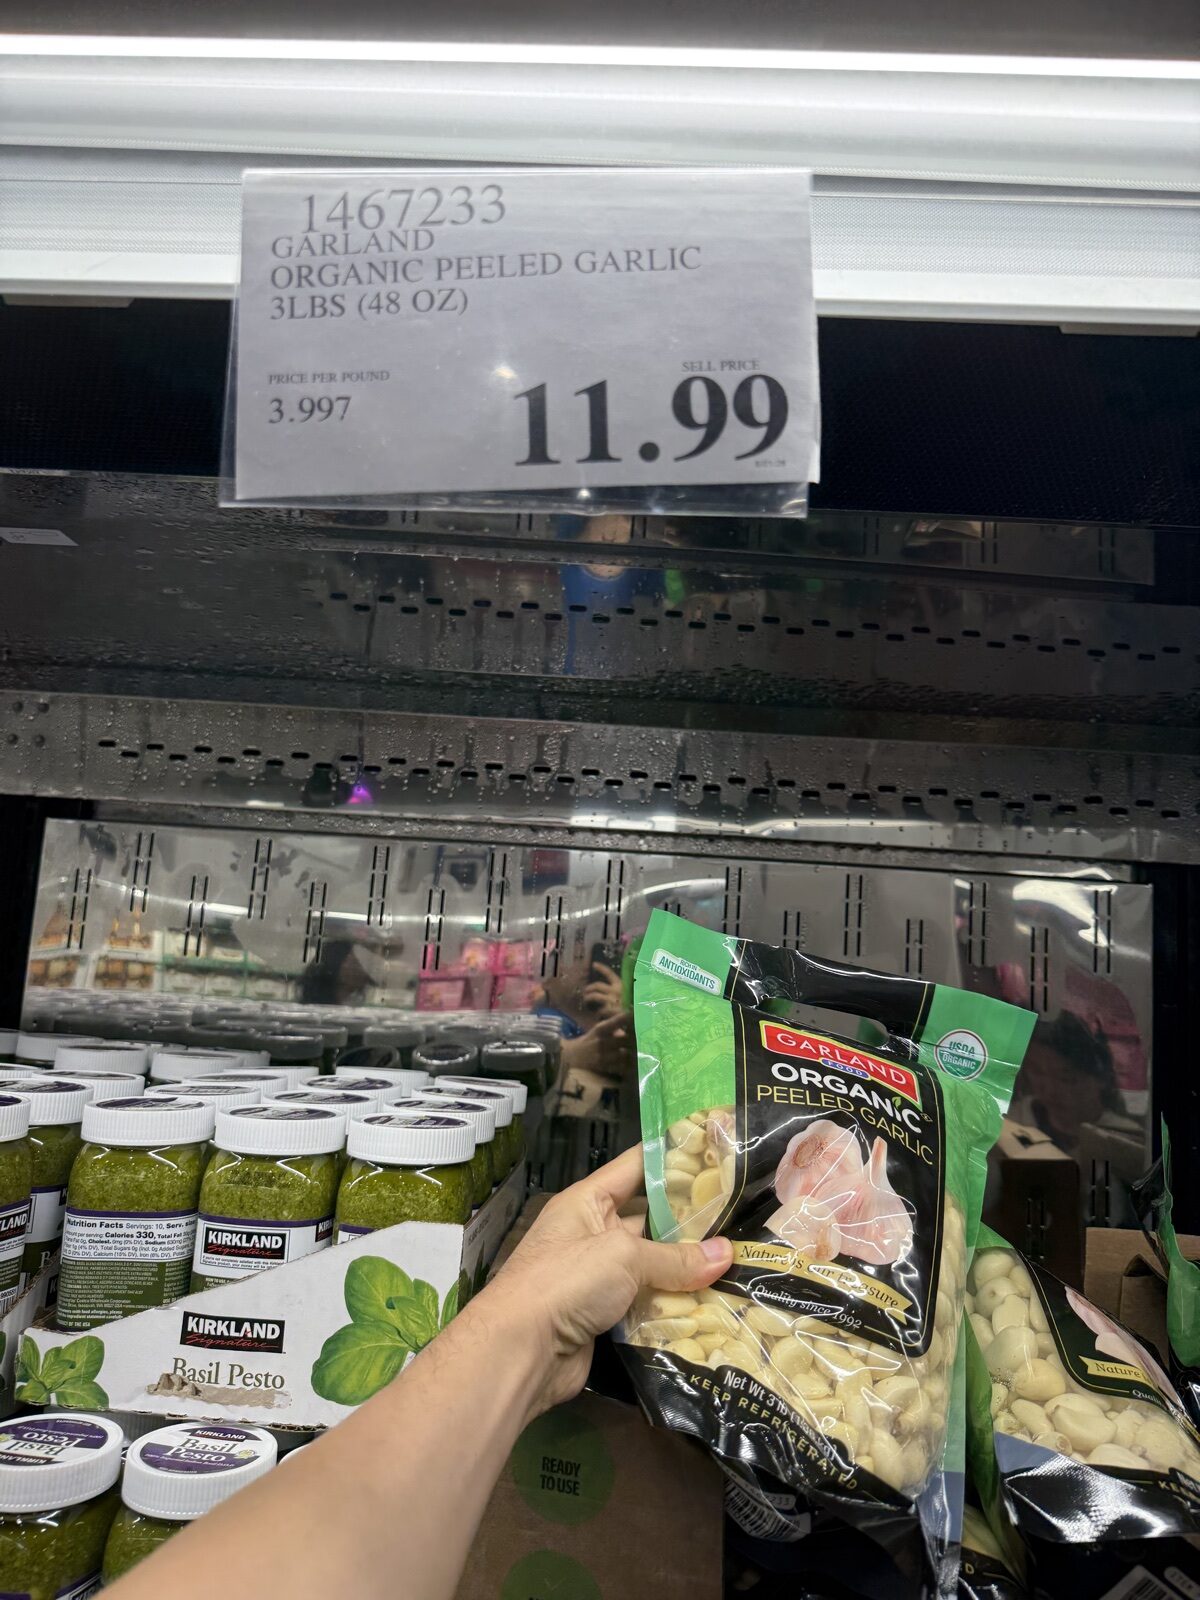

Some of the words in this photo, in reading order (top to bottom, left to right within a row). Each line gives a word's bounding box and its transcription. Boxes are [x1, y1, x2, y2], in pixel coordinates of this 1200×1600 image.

[302, 184, 506, 234] 1467233
[271, 229, 435, 259] GARLAND
[270, 258, 424, 290] ORGANIC
[436, 253, 563, 281] PEELED
[574, 246, 701, 274] GARLIC
[270, 294, 347, 320] 3LBS
[357, 291, 401, 321] (48
[411, 288, 469, 317] OZ)
[268, 372, 309, 385] PRICE
[312, 372, 338, 384] PER
[342, 370, 391, 383] POUND
[681, 361, 716, 373] SELL
[720, 359, 761, 372] PRICE
[268, 395, 352, 424] 3.997
[512, 373, 790, 467] 11.99
[658, 955, 716, 990] ANTIOXIDANTS
[776, 1032, 907, 1086] GARLAND
[949, 1041, 976, 1055] USDA
[826, 1060, 864, 1077] FOOD
[942, 1052, 976, 1070] ORGANIC
[771, 1062, 923, 1134] ORGANIC
[756, 1084, 855, 1113] PEELED
[859, 1105, 934, 1166] GARLIC
[67, 1218, 97, 1228] Nutrition
[99, 1221, 124, 1229] Facts
[125, 1223, 154, 1231] Servings:
[105, 1231, 135, 1239] Calories
[136, 1231, 157, 1240] 330,
[207, 1230, 283, 1249] KIRKLAND
[207, 1243, 282, 1256] Signature
[754, 1284, 799, 1309] Quality
[799, 1297, 832, 1316] since
[833, 1311, 863, 1331] 1992
[187, 1315, 281, 1340] KIRKLAND
[186, 1333, 279, 1350] Signature
[172, 1357, 221, 1386] Basil
[227, 1363, 286, 1389] Pesto
[1095, 1362, 1141, 1379] Nature
[724, 1369, 746, 1391] Net
[749, 1380, 766, 1401] Wt
[766, 1393, 775, 1407] 3
[775, 1396, 788, 1416] lb
[22, 1431, 86, 1448] Pesto
[196, 1429, 247, 1440] KIRKLAND
[690, 1373, 732, 1403] KEEP
[737, 1396, 859, 1491] REFRIGERATED
[5, 1441, 67, 1455] Basil
[163, 1446, 227, 1462] Pesto
[180, 1437, 239, 1453] Basil
[541, 1456, 582, 1479] READY
[540, 1474, 556, 1491] TO
[557, 1477, 581, 1497] USE
